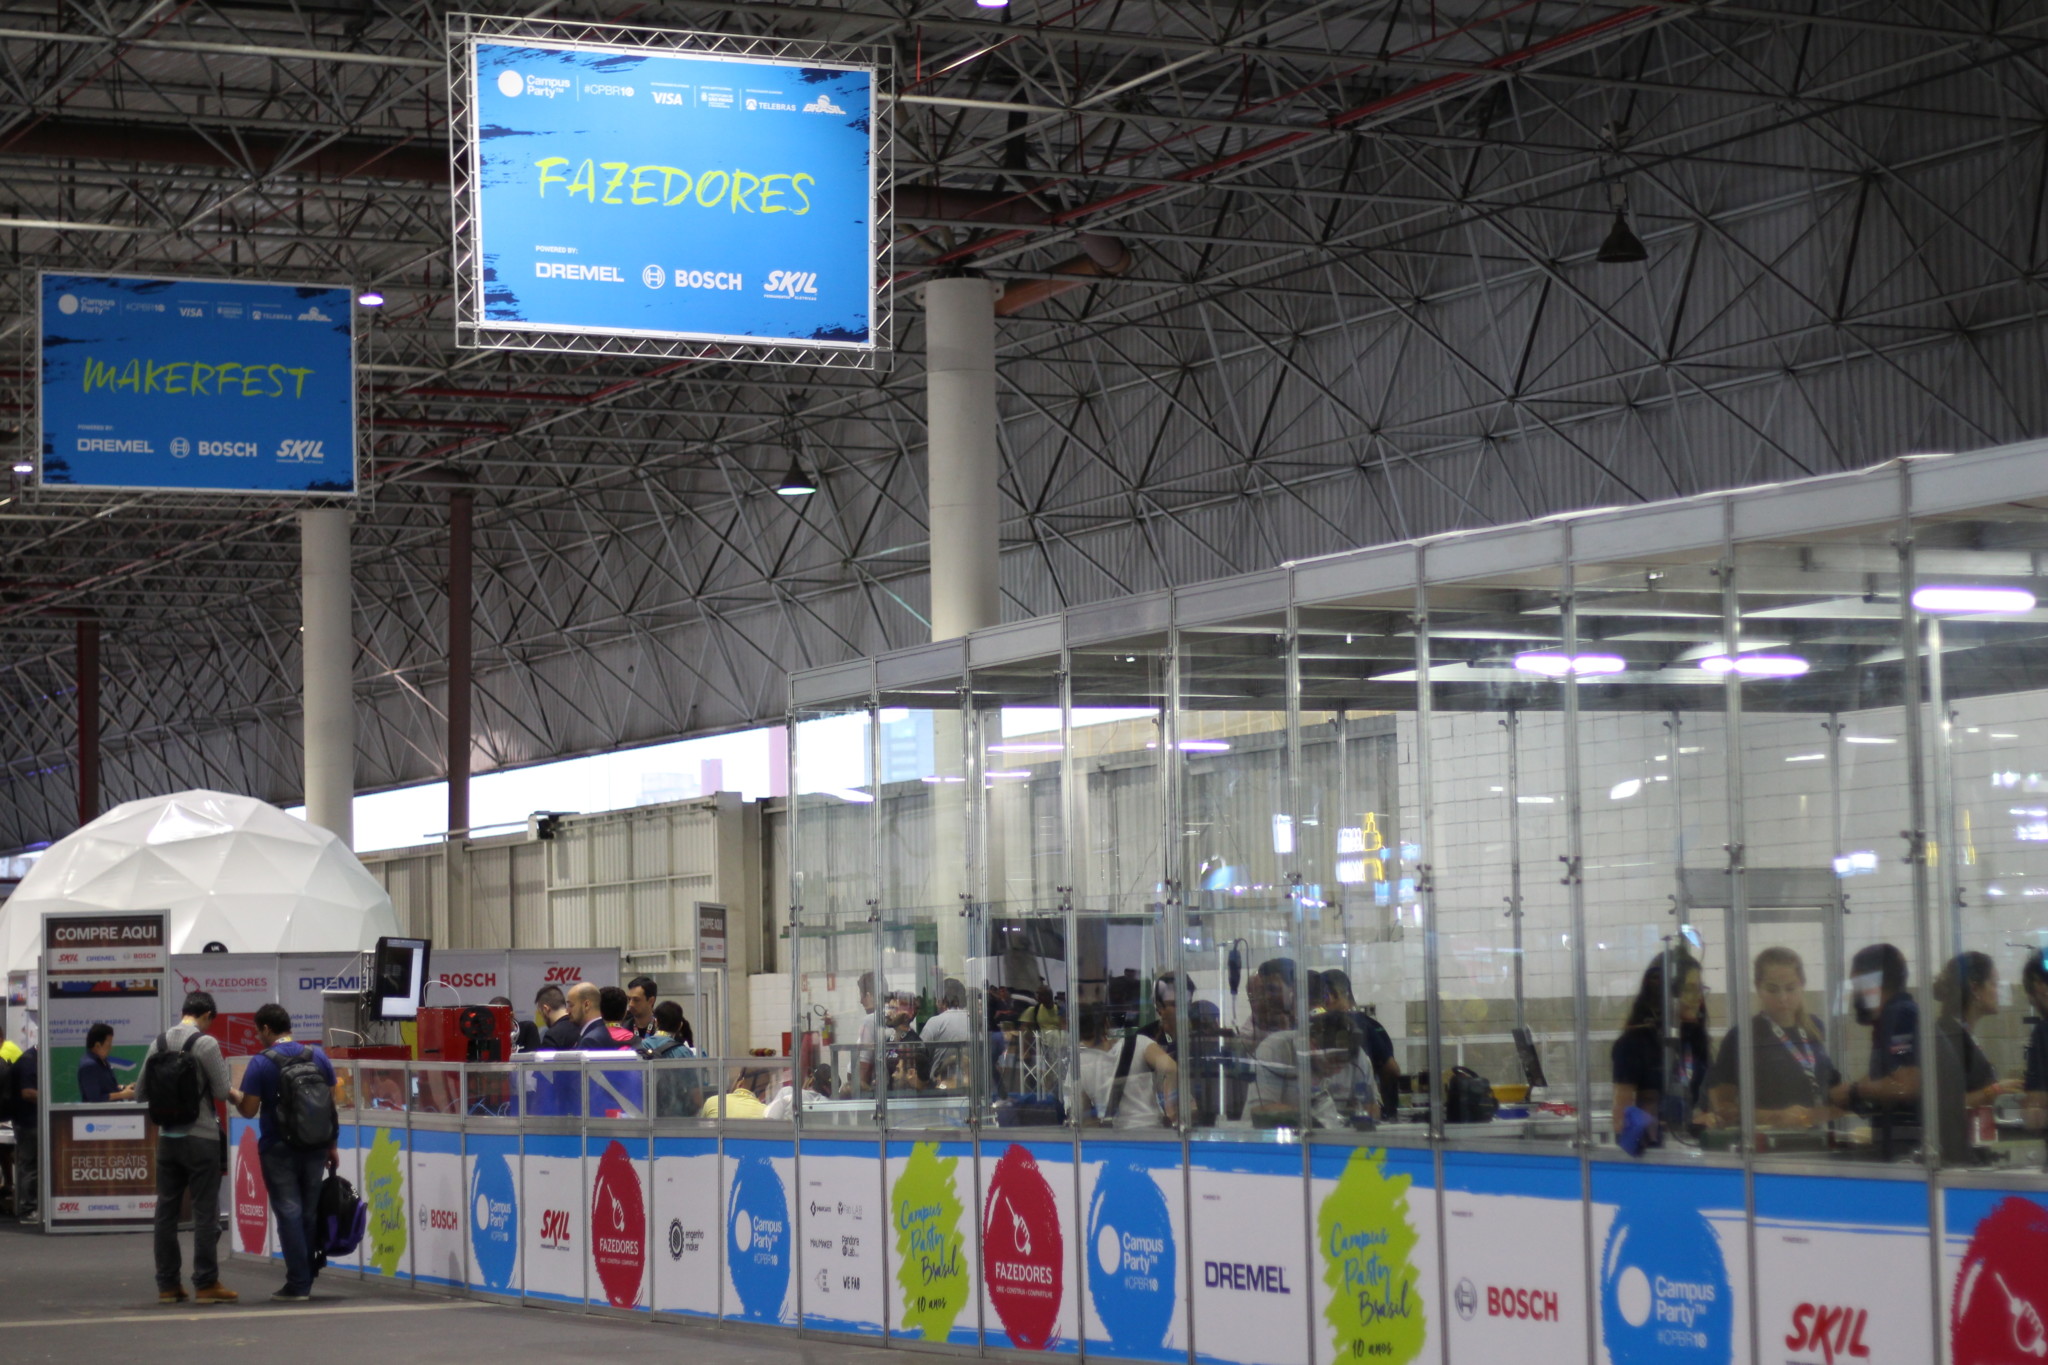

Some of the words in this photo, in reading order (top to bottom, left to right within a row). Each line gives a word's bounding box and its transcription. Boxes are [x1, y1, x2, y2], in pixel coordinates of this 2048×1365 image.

[527, 75, 570, 88] Campus
[584, 84, 635, 97] #CPBR10
[652, 92, 683, 105] VISA
[759, 102, 796, 111] TELEBRAS
[802, 103, 846, 114] BRASIL
[534, 157, 815, 215] FAZEDORES
[536, 245, 566, 254] POWERED
[568, 247, 578, 255] BY:
[536, 262, 624, 283] DREMEL
[675, 270, 742, 291] BOSCH
[764, 270, 818, 297] SKIL
[178, 307, 203, 317] VISA
[83, 356, 315, 399] MAKERFEST
[78, 438, 154, 453] DREMEL
[198, 441, 257, 457] BOSCH
[276, 440, 324, 461] SKIL
[56, 926, 118, 941] COMPRE
[121, 926, 157, 940] AQUI
[58, 954, 78, 963] SKIL
[206, 978, 268, 988] FAZEDORES
[298, 976, 368, 990] DREME
[440, 972, 496, 988] BOSCH
[544, 966, 582, 985] SKIL
[72, 1156, 106, 1168] FRETE
[108, 1153, 148, 1168] GRÁTIS
[72, 1168, 148, 1181] EXCLUSIVO
[57, 1202, 80, 1212] SKIL
[490, 1198, 511, 1216] Campus
[901, 1200, 943, 1231] Campus
[430, 1209, 458, 1231] BOSCH
[540, 1209, 570, 1247] SKIL
[753, 1216, 782, 1236] Campus
[686, 1230, 704, 1241] engenho
[842, 1235, 859, 1246] Pandora
[911, 1222, 945, 1265] Party
[1123, 1232, 1163, 1256] Campus
[1330, 1222, 1390, 1263] Campus
[600, 1238, 639, 1255] FAZEDORES
[686, 1243, 699, 1251] maker
[921, 1245, 959, 1285] Brasil
[996, 1262, 1053, 1285] FAZEDORES
[842, 1276, 851, 1290] WE
[851, 1276, 860, 1291] FAB
[1124, 1276, 1159, 1292] #CPBR10
[1204, 1260, 1291, 1294] DREMEL
[1344, 1252, 1391, 1304] Party
[1656, 1276, 1715, 1304] Campus
[917, 1296, 926, 1313] 10
[928, 1297, 947, 1310] anos
[1358, 1280, 1413, 1327] Brasil
[1488, 1286, 1559, 1322] BOSCH
[1657, 1329, 1707, 1349] #CPBR10
[1785, 1302, 1870, 1365] SKIL
[1352, 1338, 1365, 1359] 10
[1368, 1341, 1394, 1356] anos
